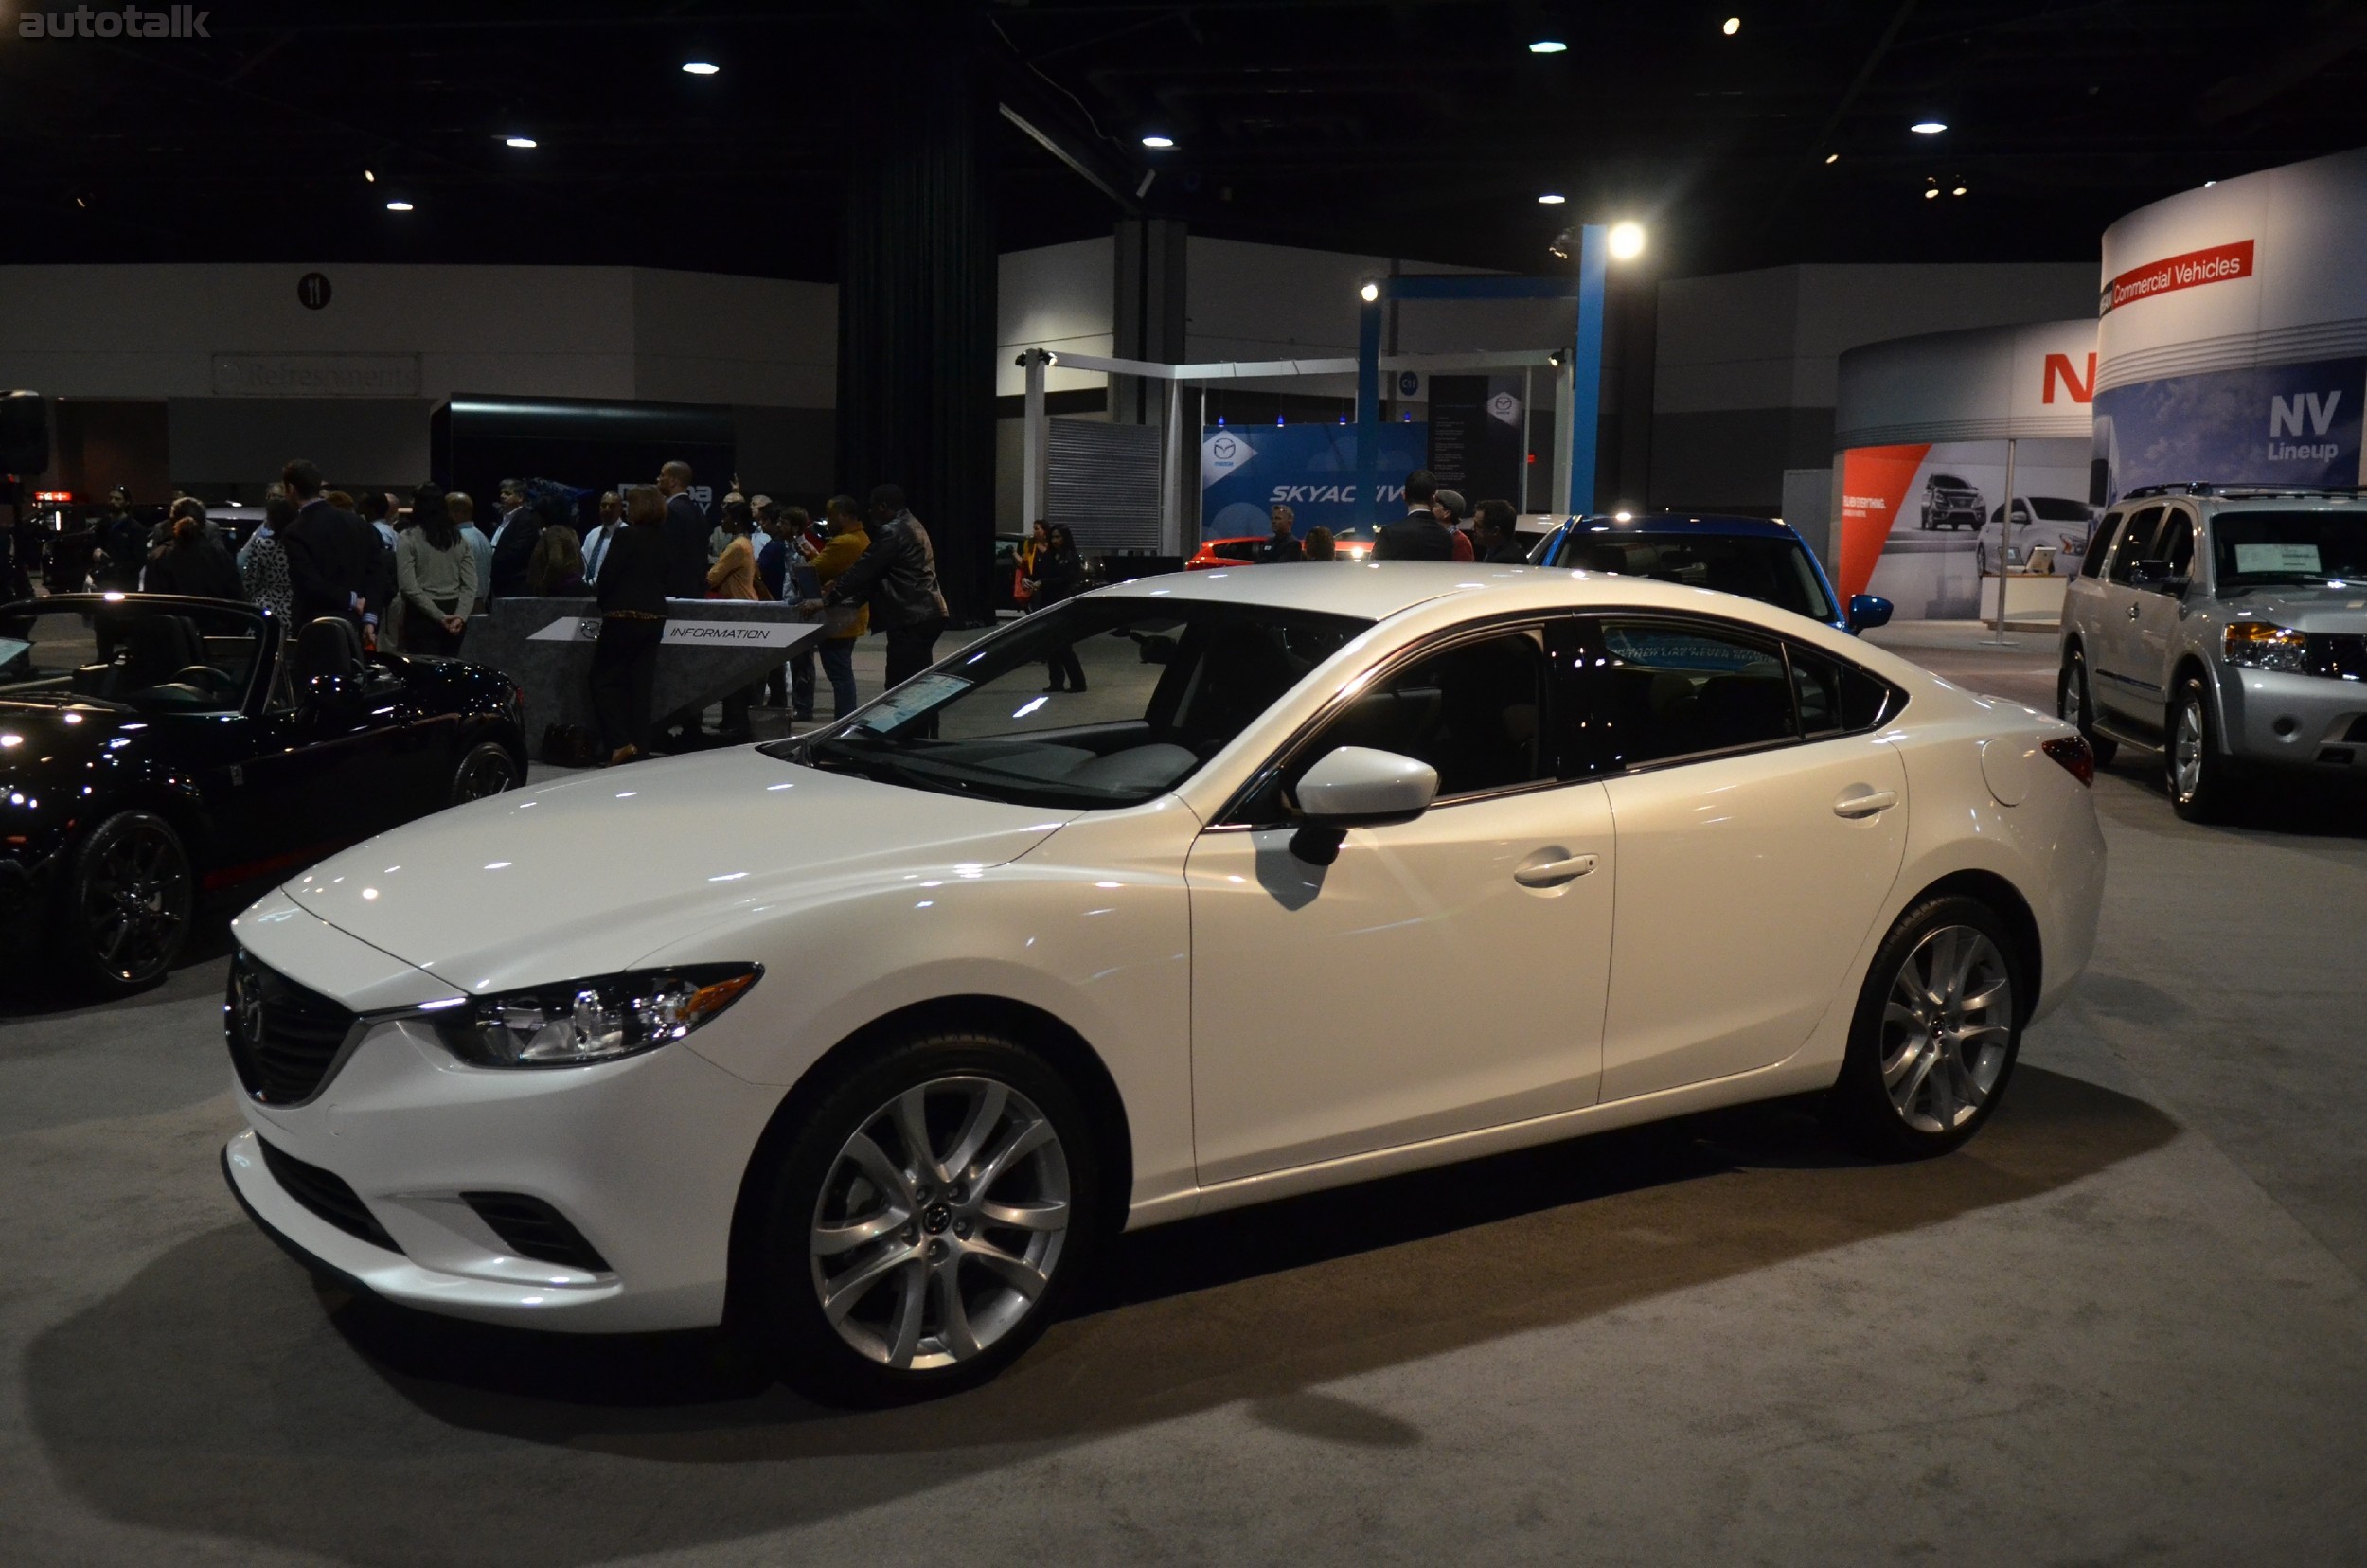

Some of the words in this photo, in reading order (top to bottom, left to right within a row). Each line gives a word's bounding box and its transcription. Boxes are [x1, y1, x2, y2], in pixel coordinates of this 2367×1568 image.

[2114, 265, 2172, 304] Commercial
[2175, 256, 2240, 285] Vehicles
[2269, 389, 2343, 437] NV
[2267, 440, 2339, 463] Lineup
[669, 627, 771, 640] INFORMATION
